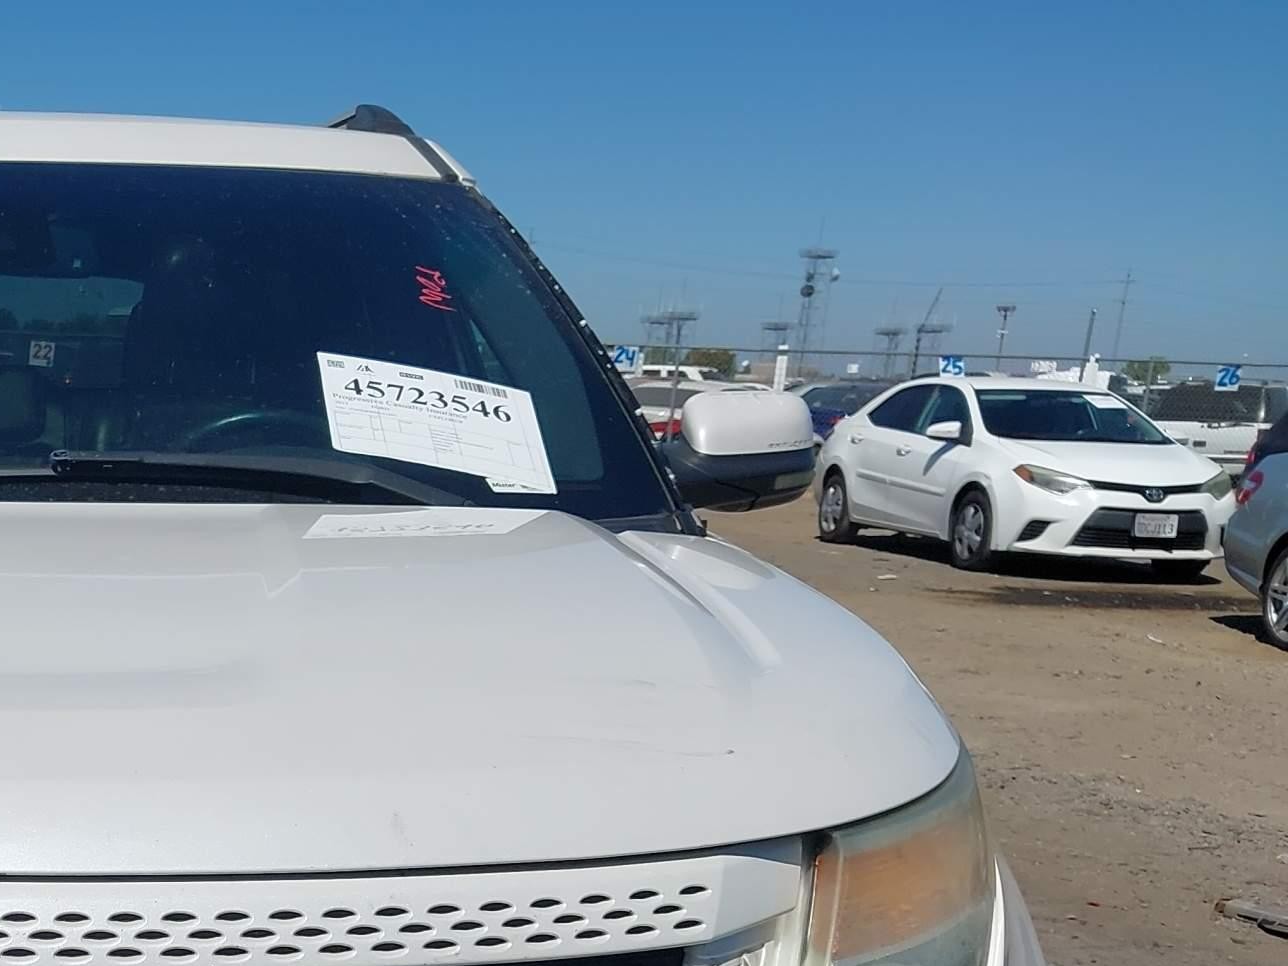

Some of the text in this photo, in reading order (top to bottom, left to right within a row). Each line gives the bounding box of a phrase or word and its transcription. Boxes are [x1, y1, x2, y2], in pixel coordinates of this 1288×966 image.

[614, 345, 637, 367] 24
[940, 355, 963, 376] 25
[1216, 366, 1241, 387] 26
[343, 377, 513, 423] 45723546
